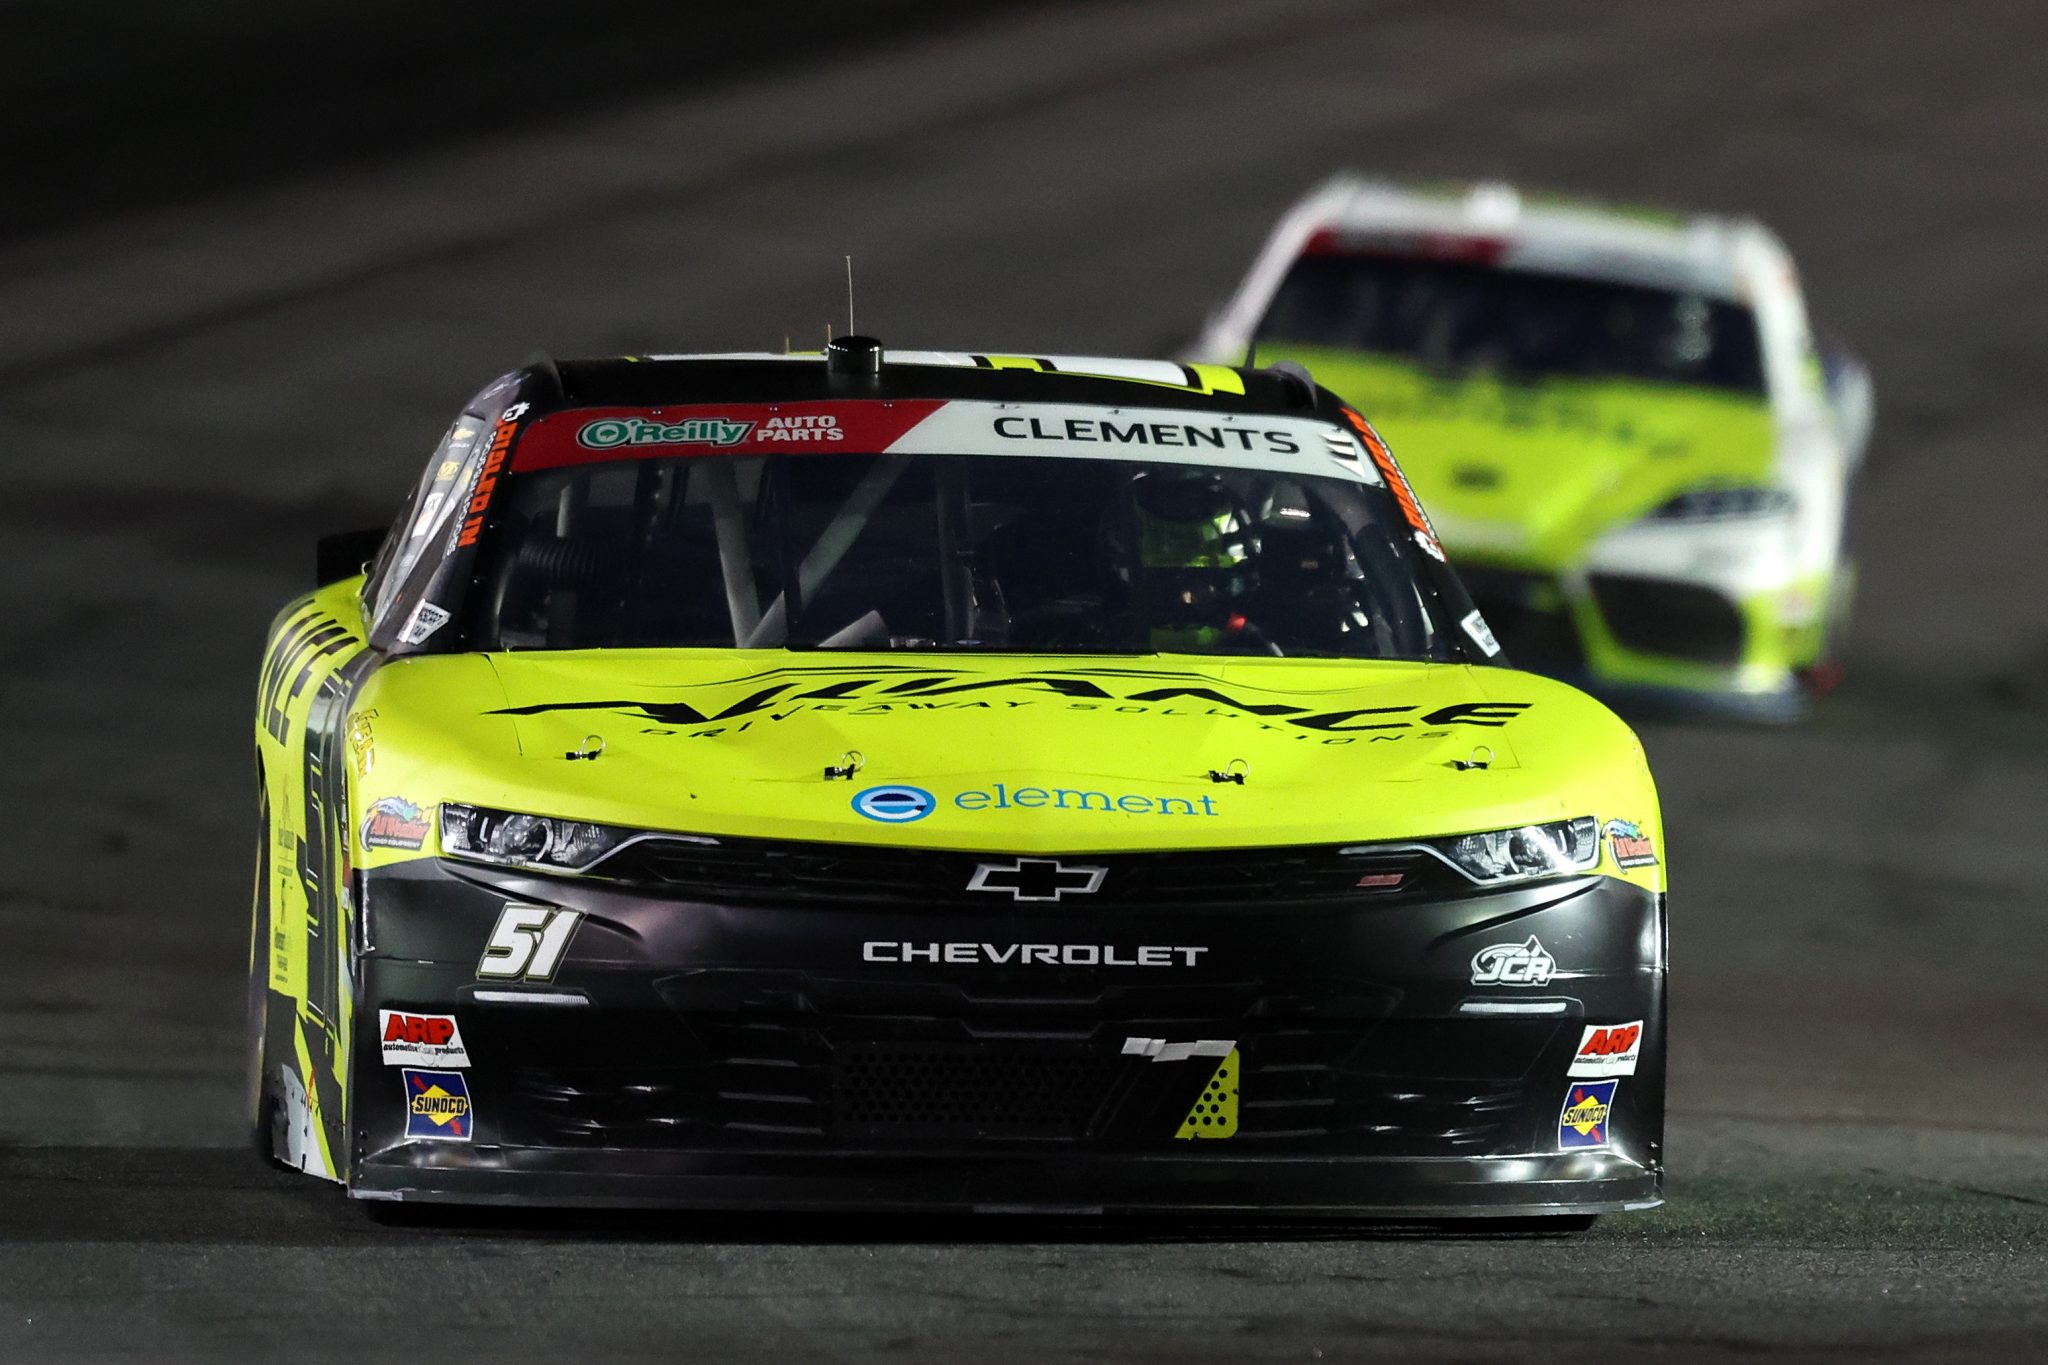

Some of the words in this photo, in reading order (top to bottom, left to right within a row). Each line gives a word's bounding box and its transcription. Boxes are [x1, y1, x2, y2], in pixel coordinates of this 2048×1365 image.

[581, 418, 754, 448] O'Reilly
[756, 428, 844, 442] PARTS
[765, 416, 836, 429] AUTO
[993, 416, 1300, 455] CLEMENTS
[639, 700, 1034, 738] DRIVEAWAY
[1065, 702, 1452, 745] SOLUTIONS
[954, 783, 1219, 816] element
[476, 902, 587, 984] 51
[863, 941, 1208, 967] CHEVROLET
[383, 1013, 455, 1046] ARP
[1578, 1024, 1640, 1056] ARP
[414, 1096, 466, 1115] SUNOCO
[1565, 1106, 1606, 1124] SUNOCO
